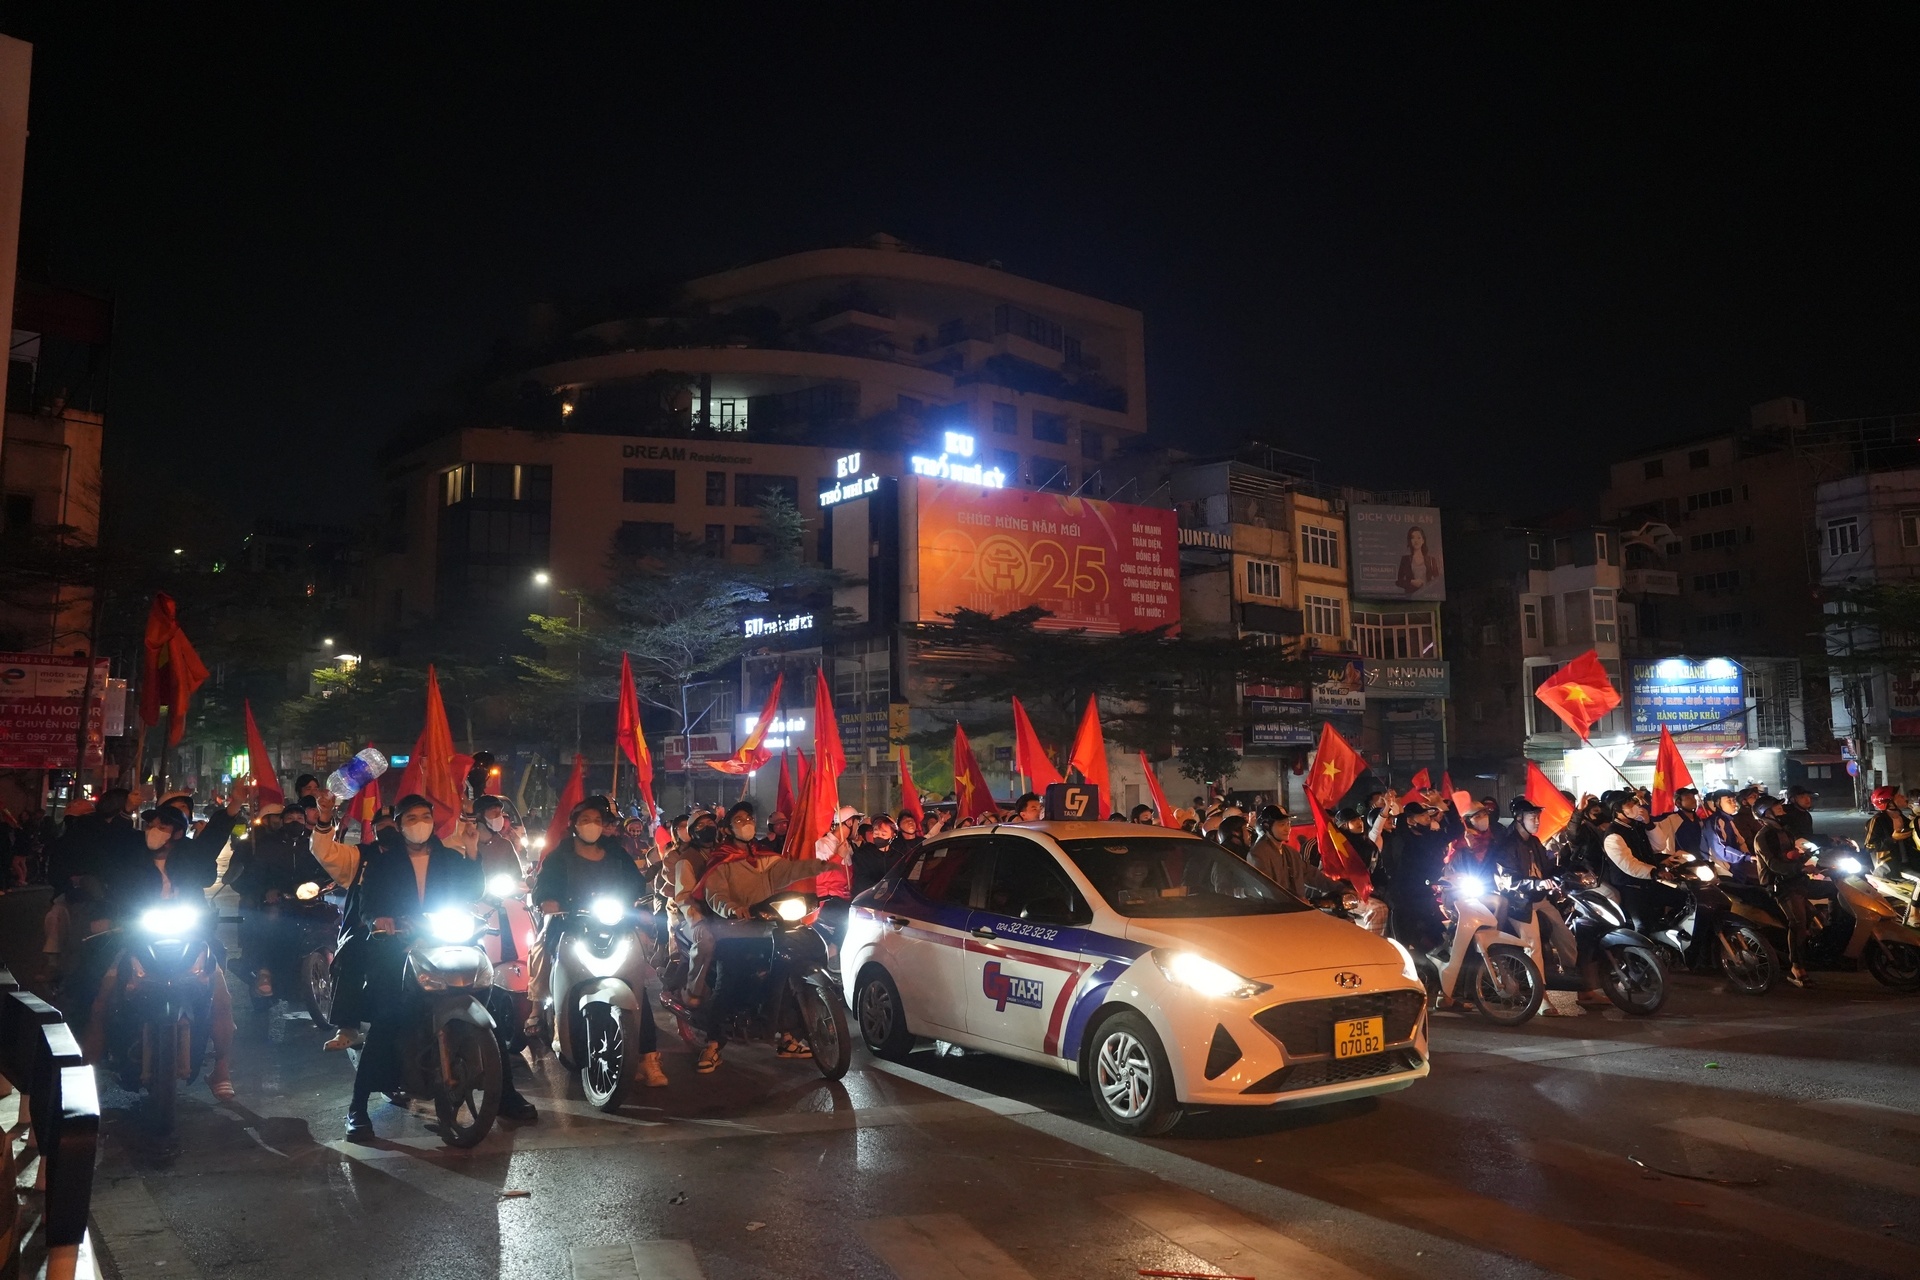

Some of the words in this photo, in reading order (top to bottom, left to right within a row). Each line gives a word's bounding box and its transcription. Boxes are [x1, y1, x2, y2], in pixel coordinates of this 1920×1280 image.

[945, 431, 974, 457] EU
[622, 445, 686, 461] DREAM
[690, 453, 753, 465] Residences
[837, 452, 861, 479] EU
[958, 511, 991, 526] CHÚC
[995, 515, 1028, 531] MỪNG
[1032, 520, 1057, 535] NĂM
[1061, 523, 1081, 537] MỚI
[1404, 513, 1415, 523] IN
[1145, 526, 1162, 537] MẠNH
[1132, 536, 1147, 547] TOÀN
[1140, 579, 1160, 592] NGHIỆP
[1386, 667, 1399, 678] IN
[1401, 667, 1445, 678] NHANH
[1634, 664, 1654, 682] QUẠT
[12, 702, 47, 716] THÁI
[1656, 710, 1677, 720] HÀNG
[1679, 709, 1698, 722] NHẬP
[1700, 707, 1720, 720] KHẨU
[15, 718, 59, 729] CHUYÊN
[62, 720, 101, 731] NGỆP
[842, 713, 862, 724] THAN
[27, 732, 47, 741] 096
[674, 737, 718, 753] TOHIBA
[996, 922, 1008, 931] 024
[1008, 922, 1020, 934] 32
[1020, 925, 1033, 936] 32
[1031, 927, 1045, 939] 32
[1043, 929, 1058, 941] 32
[1010, 978, 1042, 1002] TAXI
[1349, 1021, 1370, 1038] 29E
[1341, 1036, 1379, 1056] 070.82
